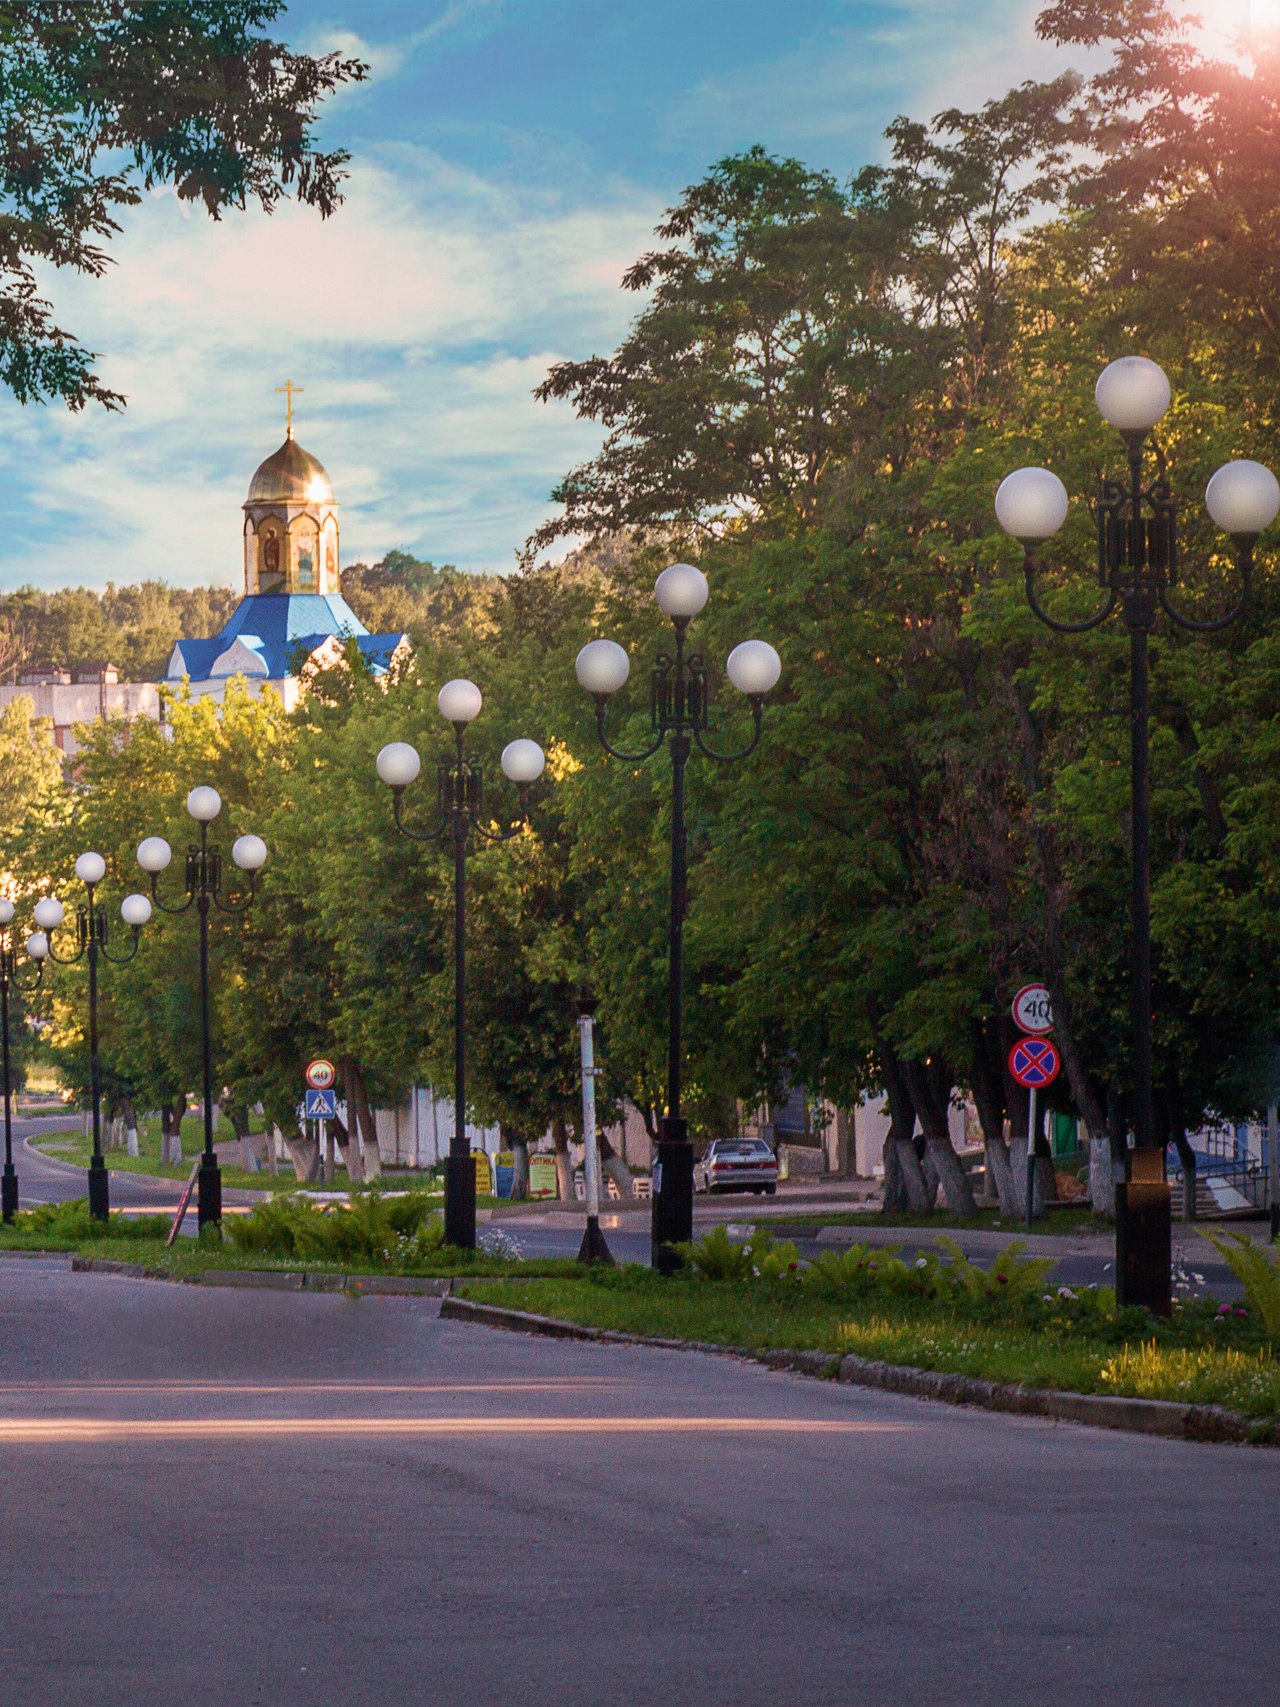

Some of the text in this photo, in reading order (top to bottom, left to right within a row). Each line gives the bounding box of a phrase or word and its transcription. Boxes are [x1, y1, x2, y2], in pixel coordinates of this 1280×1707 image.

[1023, 1001, 1049, 1017] 40
[313, 1071, 328, 1080] 40
[529, 1156, 556, 1165] ОПТИКА
